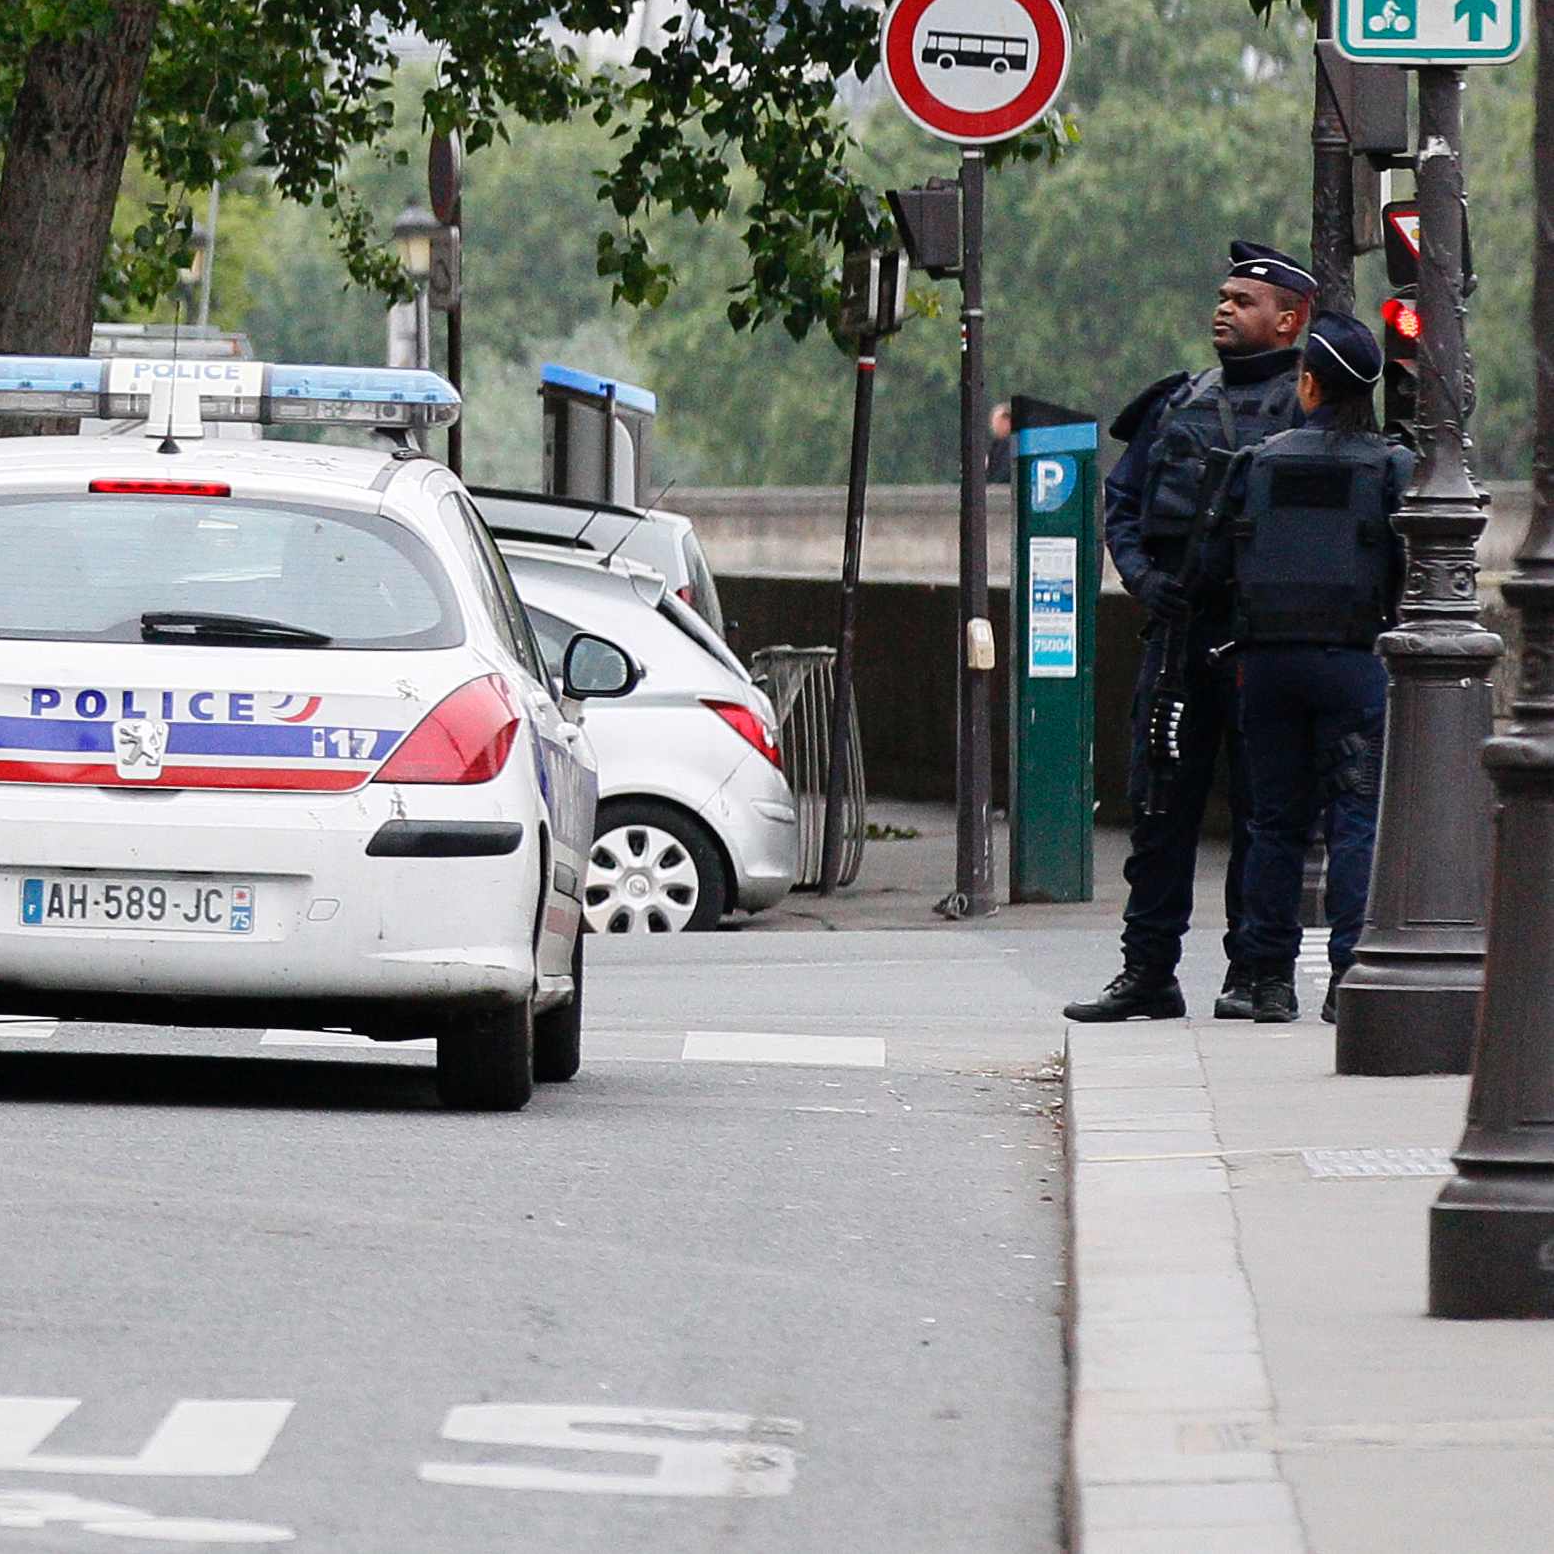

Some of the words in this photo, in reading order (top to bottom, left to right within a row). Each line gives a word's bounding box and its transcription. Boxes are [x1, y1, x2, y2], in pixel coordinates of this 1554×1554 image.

[134, 362, 240, 380] POLICE
[1037, 460, 1064, 504] P
[29, 687, 256, 722] POLICE
[328, 729, 379, 759] 17
[46, 883, 224, 924] AH-589-JC
[230, 909, 251, 929] 75
